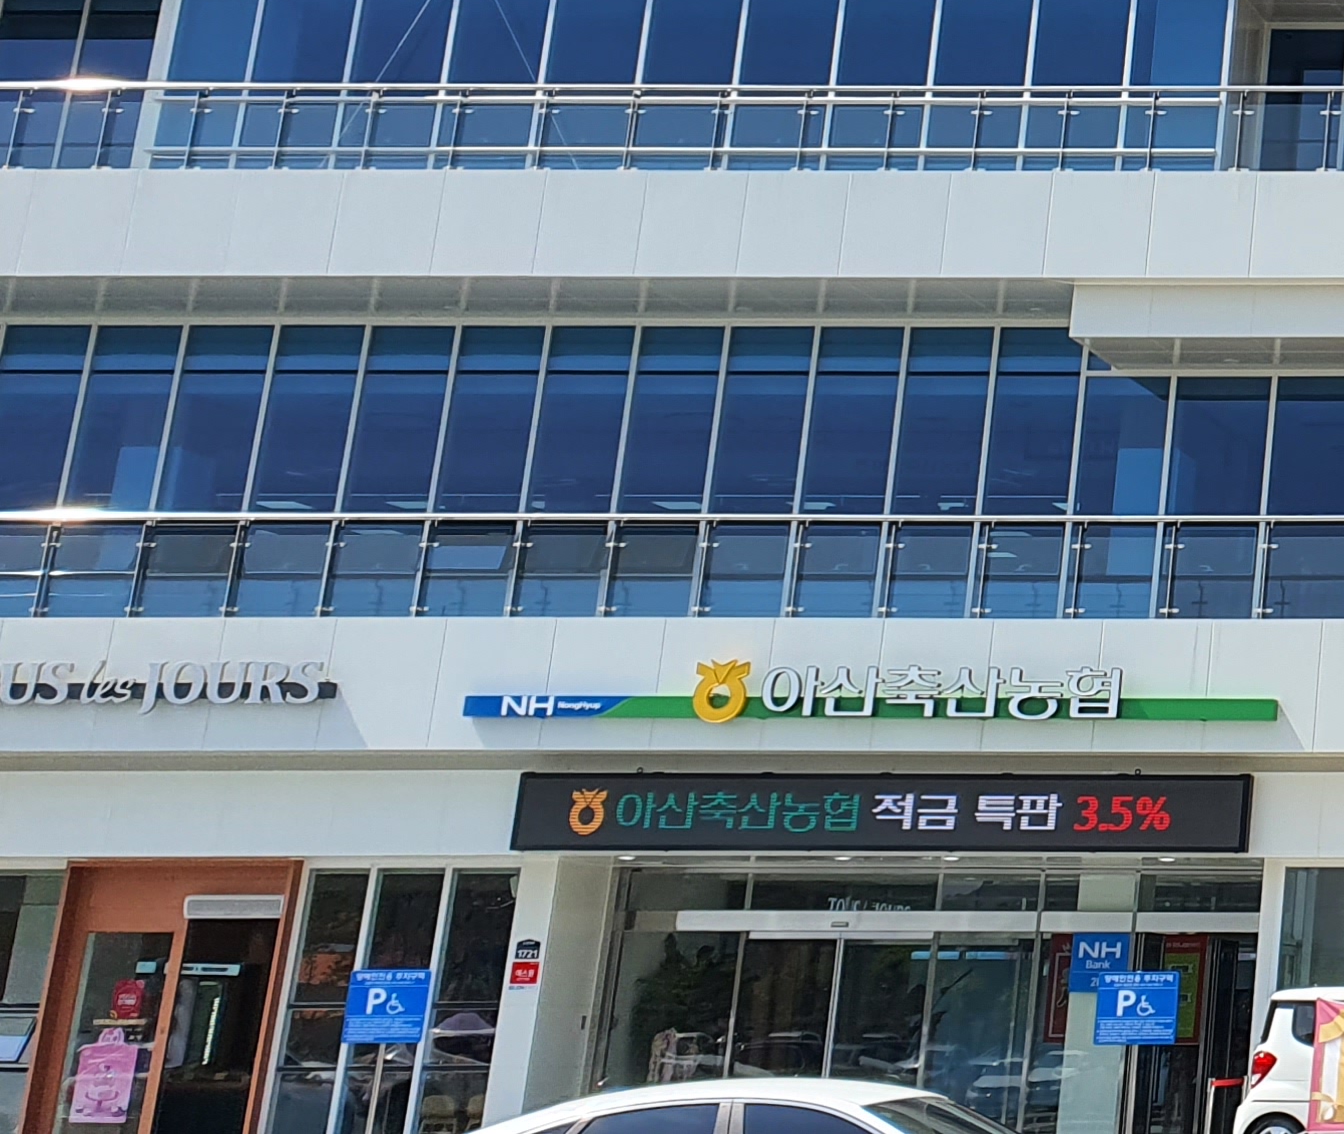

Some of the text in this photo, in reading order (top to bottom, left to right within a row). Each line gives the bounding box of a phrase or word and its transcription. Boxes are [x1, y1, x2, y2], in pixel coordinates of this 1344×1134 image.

[79, 659, 137, 705] les
[138, 660, 326, 716] JOURS
[761, 664, 1125, 720] 아산축산농협
[500, 695, 555, 717] NH
[615, 792, 1171, 832] 아산축산농협 적금 특판 3.5%
[517, 949, 538, 958] 1721
[1078, 941, 1122, 959] NH
[1086, 960, 1110, 969] Bank
[366, 987, 387, 1015] P
[1116, 989, 1137, 1017] P
